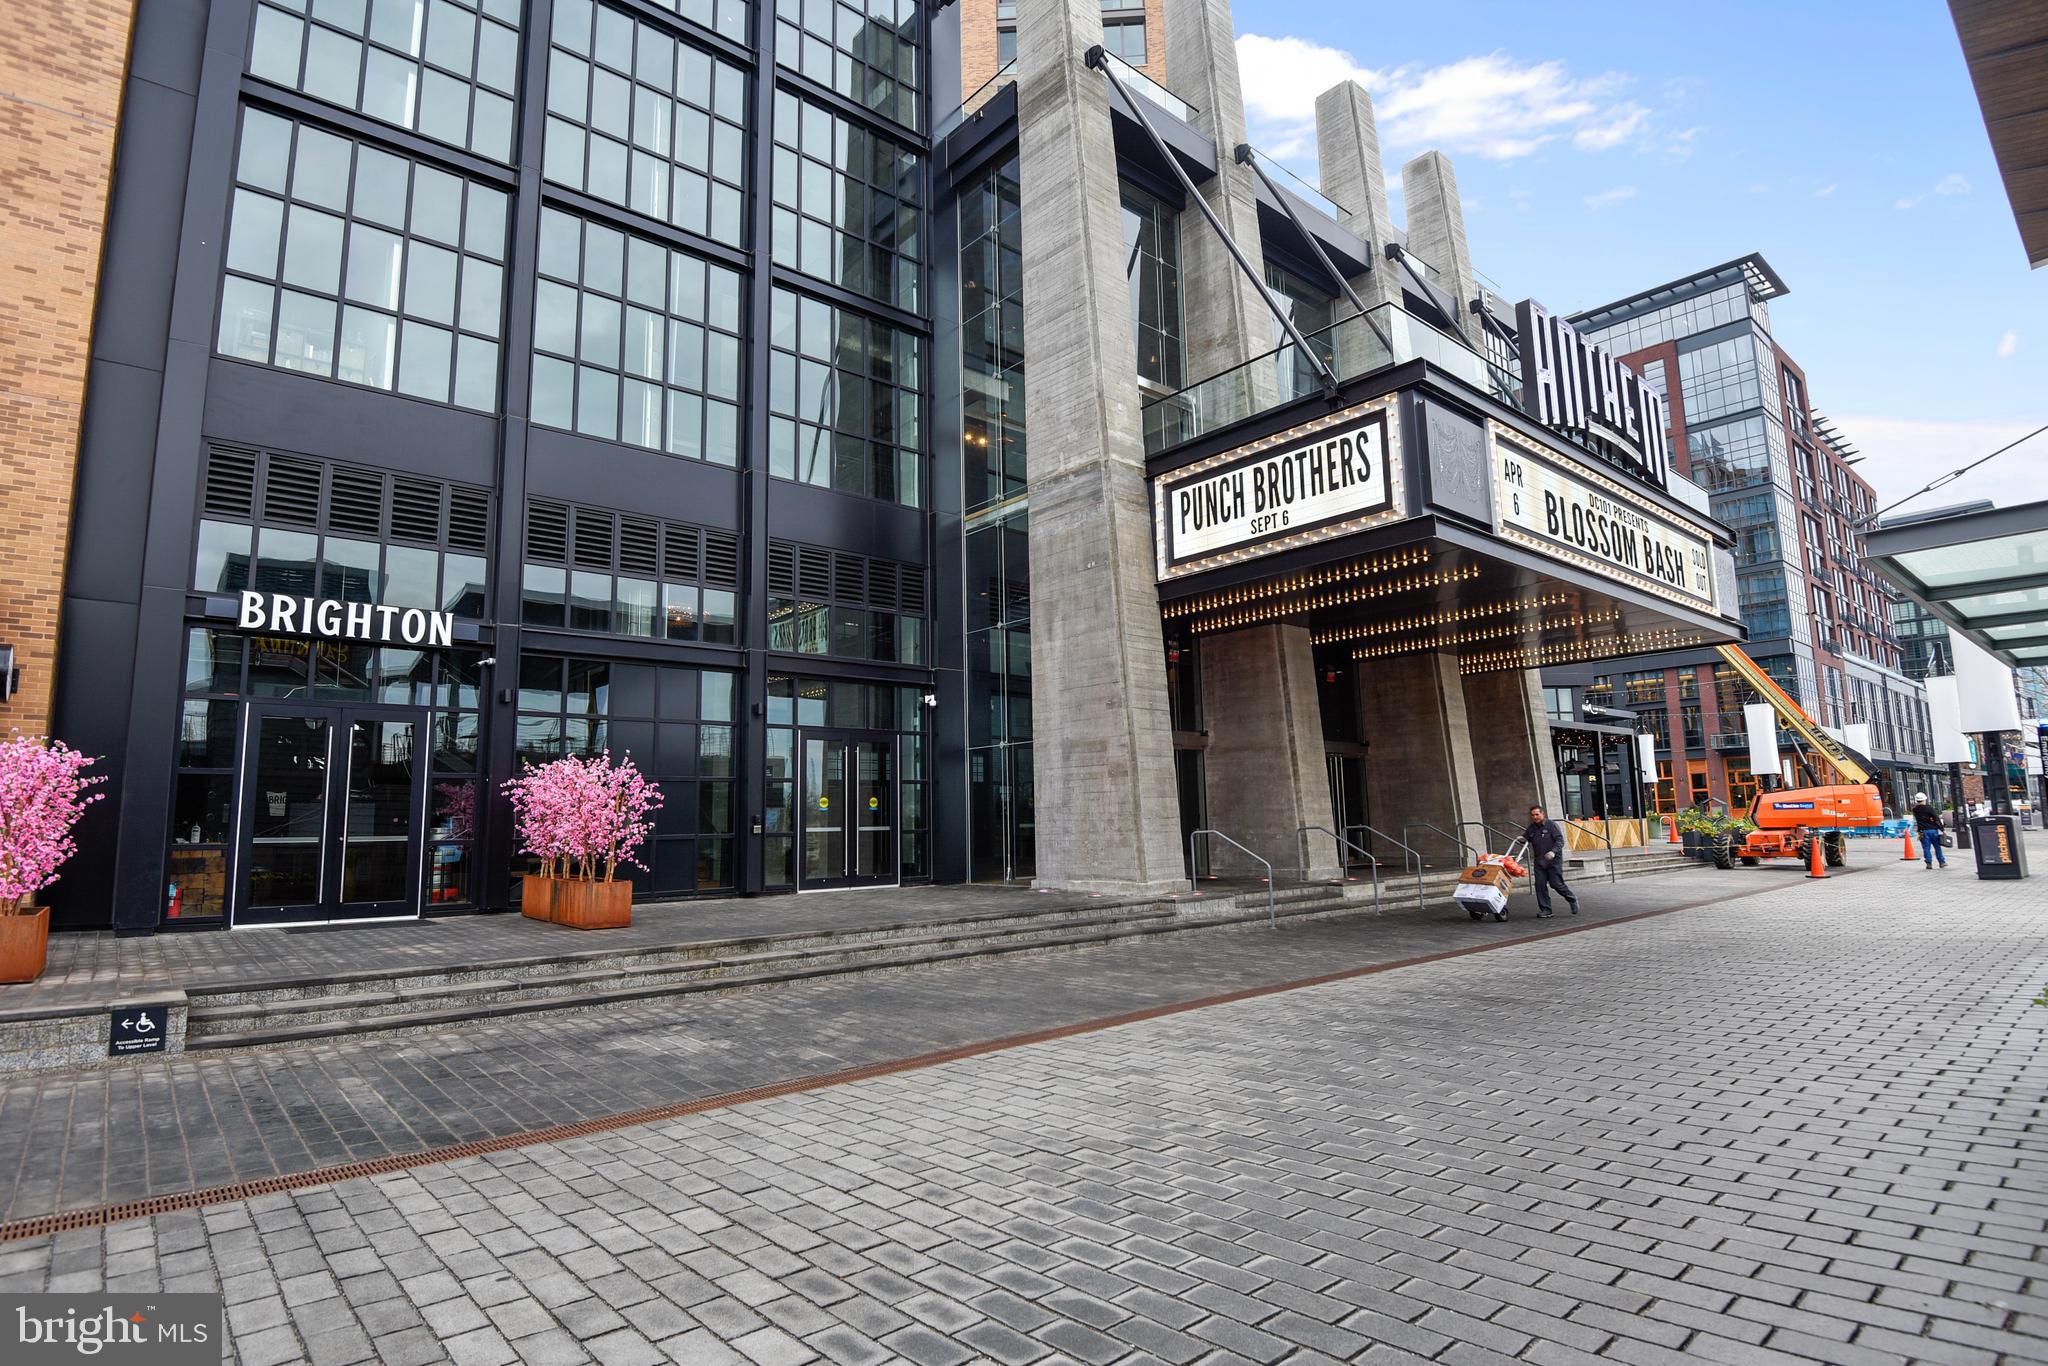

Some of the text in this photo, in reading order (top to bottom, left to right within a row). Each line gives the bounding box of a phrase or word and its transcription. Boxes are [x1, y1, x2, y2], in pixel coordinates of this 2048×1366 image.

[1530, 298, 1670, 496] ANTHEM
[1180, 431, 1371, 534] PUNCH BROTHERS
[1504, 458, 1524, 488] APR
[1513, 492, 1520, 516] 6
[1588, 493, 1649, 533] DC101 PRESENTS
[1250, 510, 1289, 534] SEPT 6
[1544, 489, 1685, 588] BLOSSOM BASH
[1691, 548, 1706, 570] SOLD
[1695, 572, 1707, 593] OUT
[239, 590, 455, 646] BRIGHTON
[1997, 832, 2012, 864] pitches
